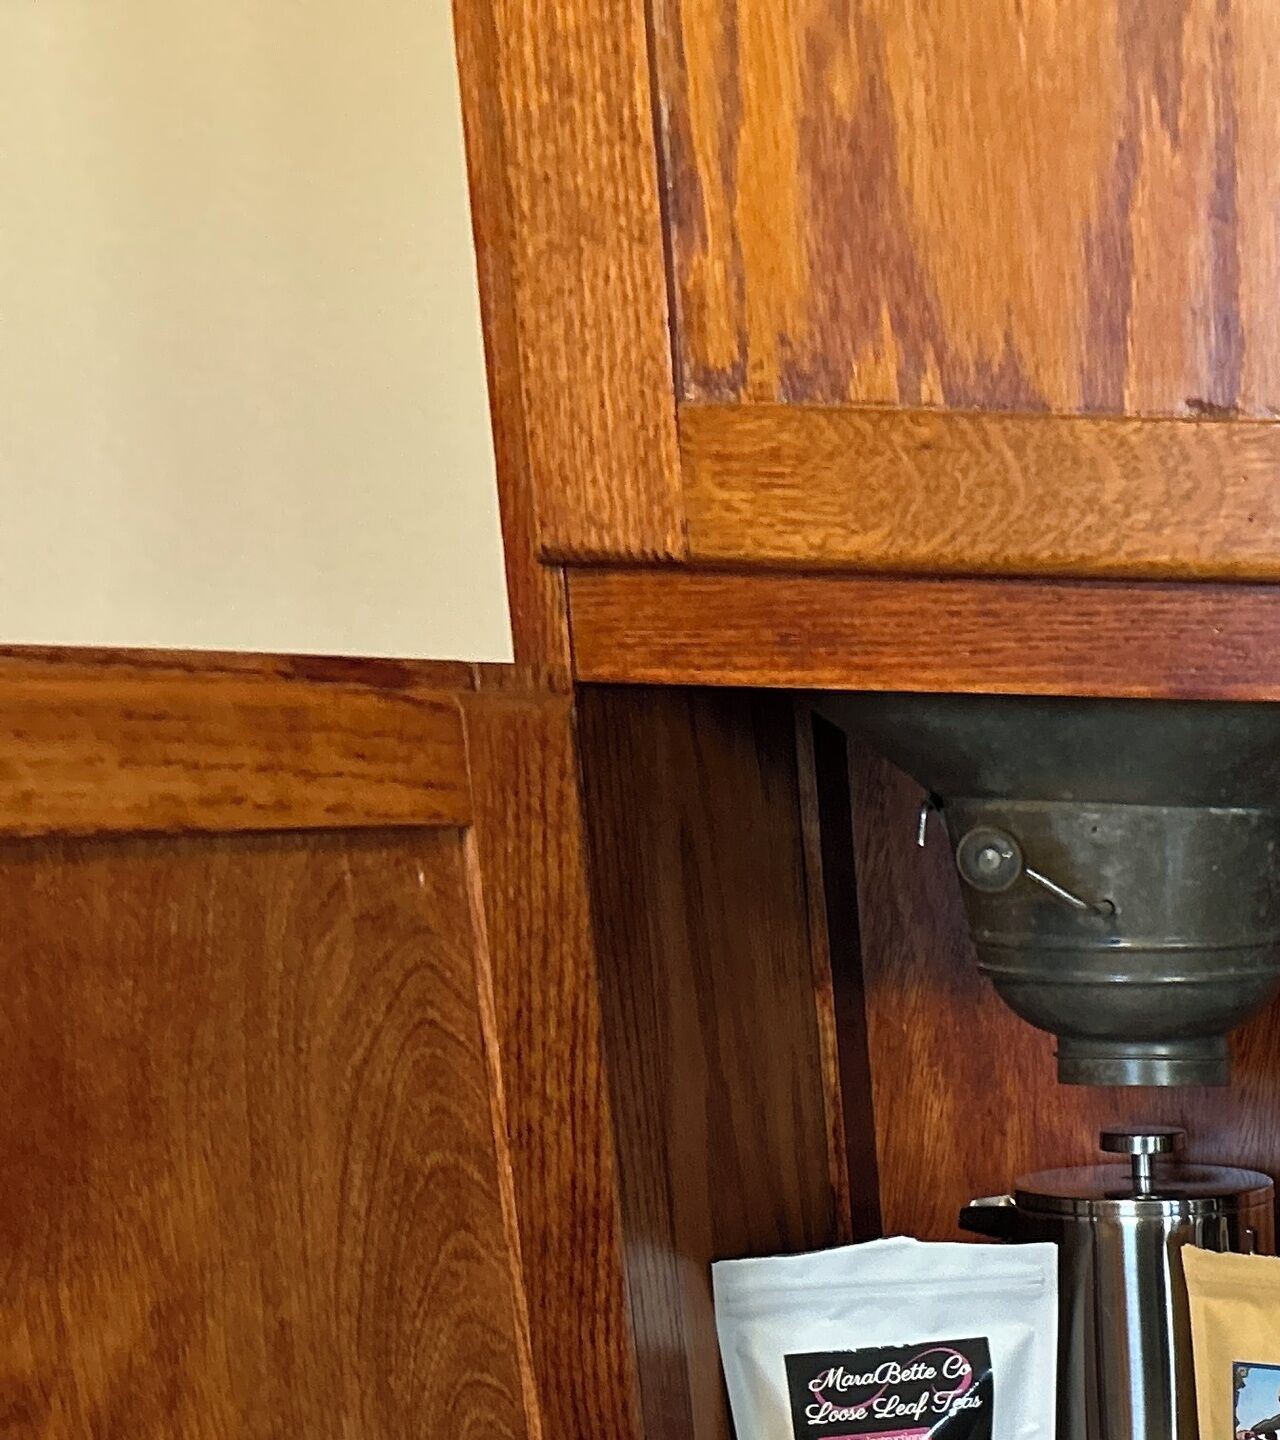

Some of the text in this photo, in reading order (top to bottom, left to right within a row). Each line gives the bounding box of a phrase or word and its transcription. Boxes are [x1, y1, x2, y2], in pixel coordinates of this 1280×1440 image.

[808, 1361, 937, 1392] MaraBette
[805, 1401, 868, 1425] Loose
[872, 1392, 930, 1420] Leaf
